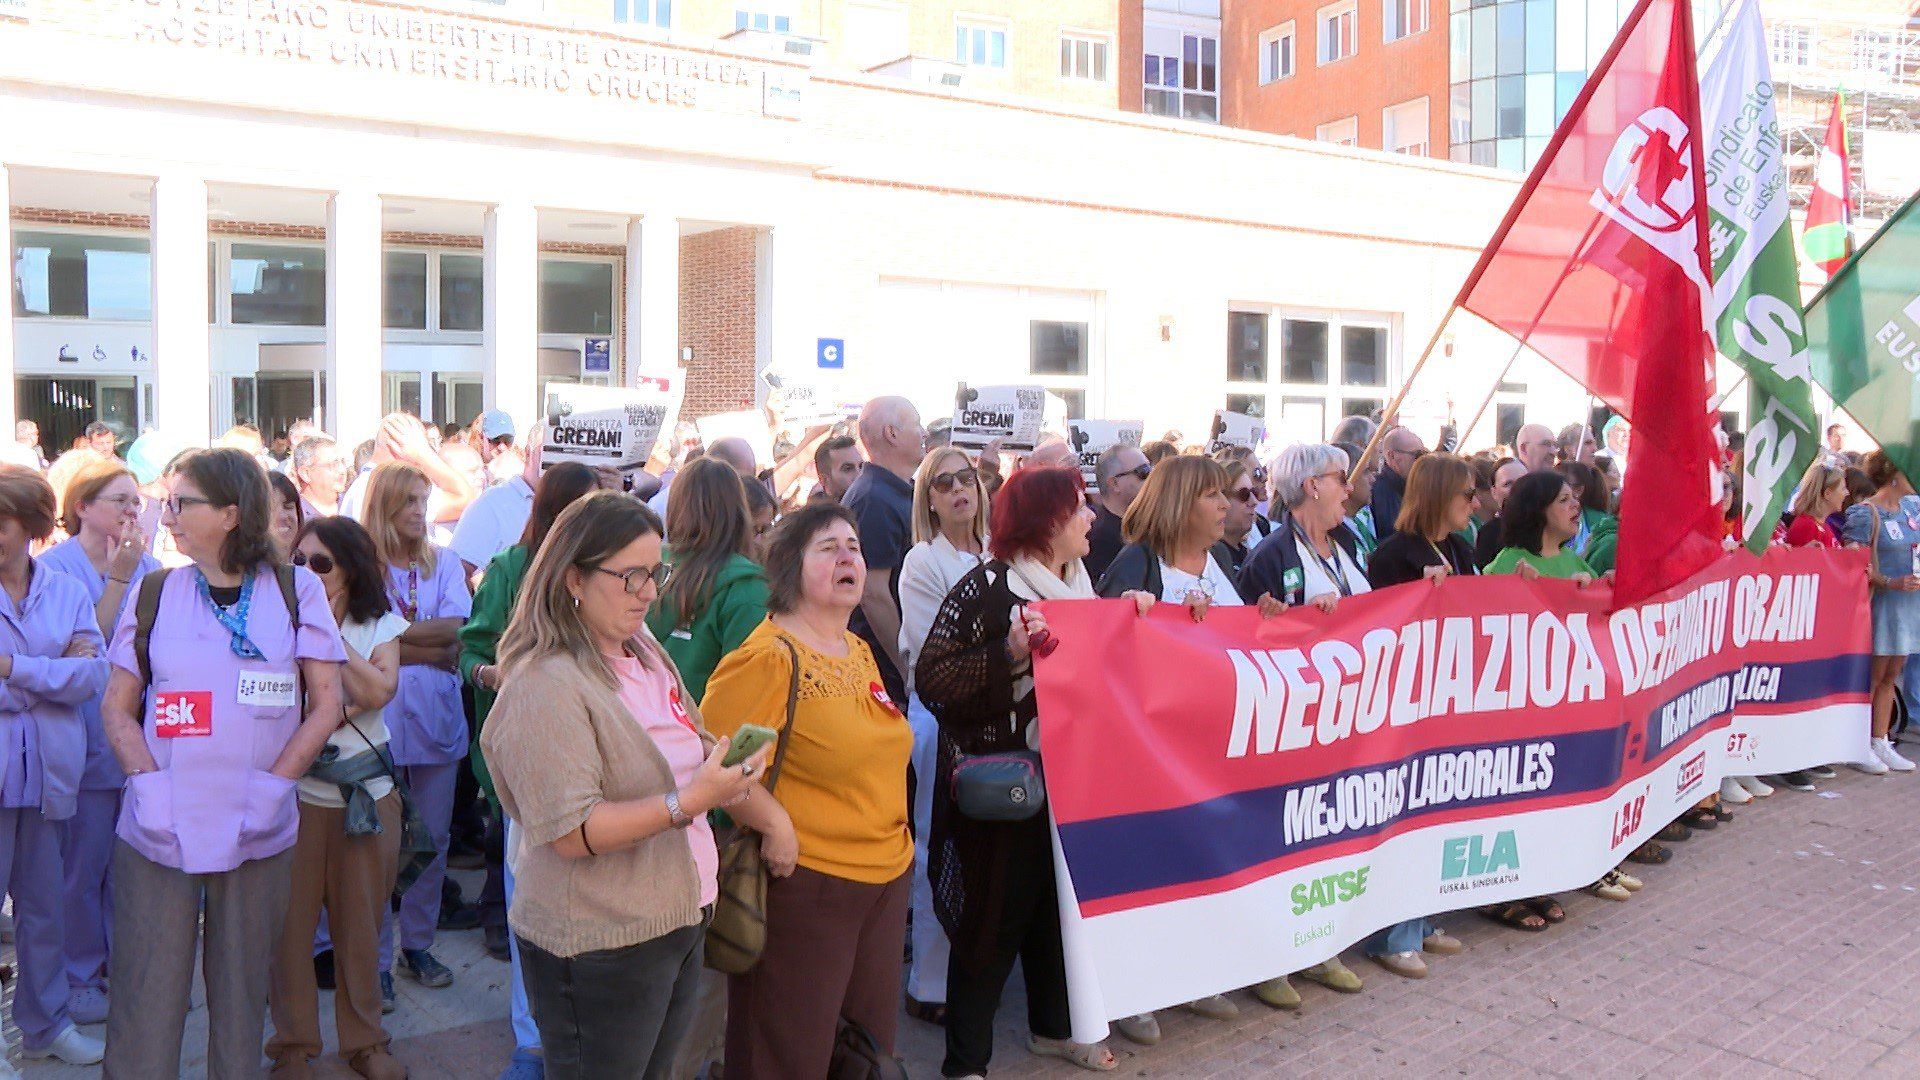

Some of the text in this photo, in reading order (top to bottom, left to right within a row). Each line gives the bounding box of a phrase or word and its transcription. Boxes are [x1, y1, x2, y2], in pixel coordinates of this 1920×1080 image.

[134, 17, 697, 108] HOSPITAL UNIVERSITARIO CRUCES
[1723, 175, 1751, 207] de
[824, 345, 838, 362] C
[553, 427, 622, 447] GREBAN!
[1226, 610, 1606, 758] NEGOZIAZIOA
[1732, 573, 1820, 648] ORAIN
[1283, 764, 1408, 846] MEJORAS
[1408, 742, 1556, 810] LABORALES
[1441, 829, 1521, 881] ELA
[1291, 865, 1371, 916] SATSE
[1439, 881, 1470, 894] EUSKAL
[1293, 920, 1336, 948] Euskadi
